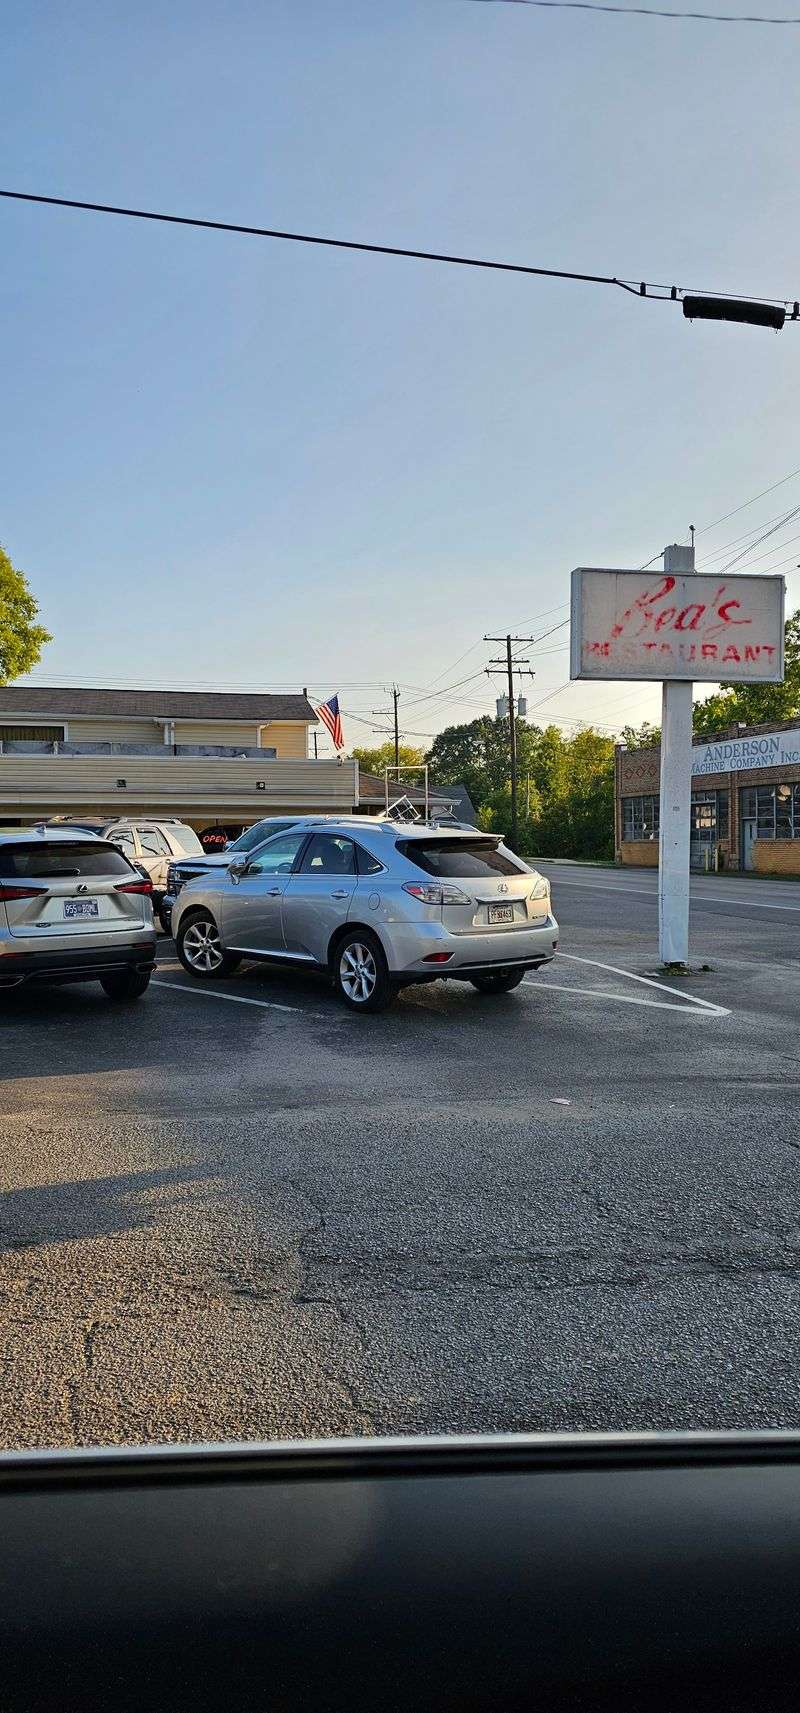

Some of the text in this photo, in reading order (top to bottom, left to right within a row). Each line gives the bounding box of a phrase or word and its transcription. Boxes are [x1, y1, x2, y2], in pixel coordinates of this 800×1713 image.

[611, 576, 752, 640] Bea's
[584, 641, 776, 664] RETAURANT
[703, 736, 781, 762] ANDERSON
[202, 834, 228, 843] OPEN
[65, 904, 77, 914] 955
